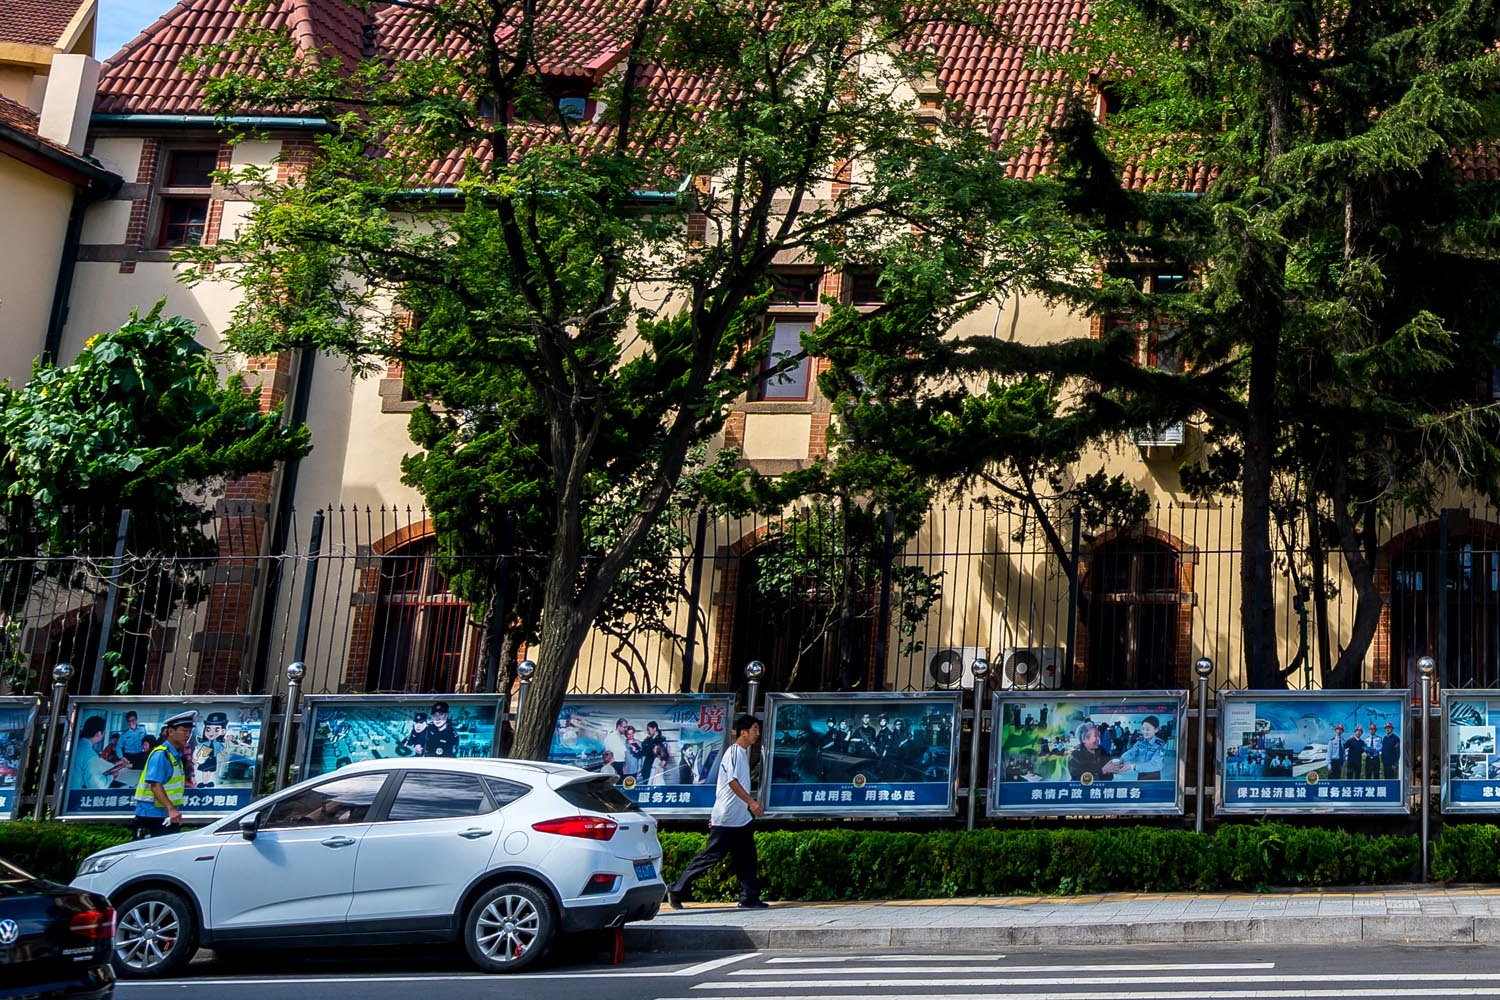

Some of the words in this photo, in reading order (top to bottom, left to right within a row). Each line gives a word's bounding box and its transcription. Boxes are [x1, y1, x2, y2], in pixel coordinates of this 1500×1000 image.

[802, 790, 852, 802] 首战用我
[865, 789, 916, 801] 用我必胜
[1031, 788, 1083, 800] 亲情户政
[1090, 787, 1141, 799] 热情服务
[1237, 787, 1307, 799] 保卫经济建设
[1318, 786, 1387, 798] 服务经济发展
